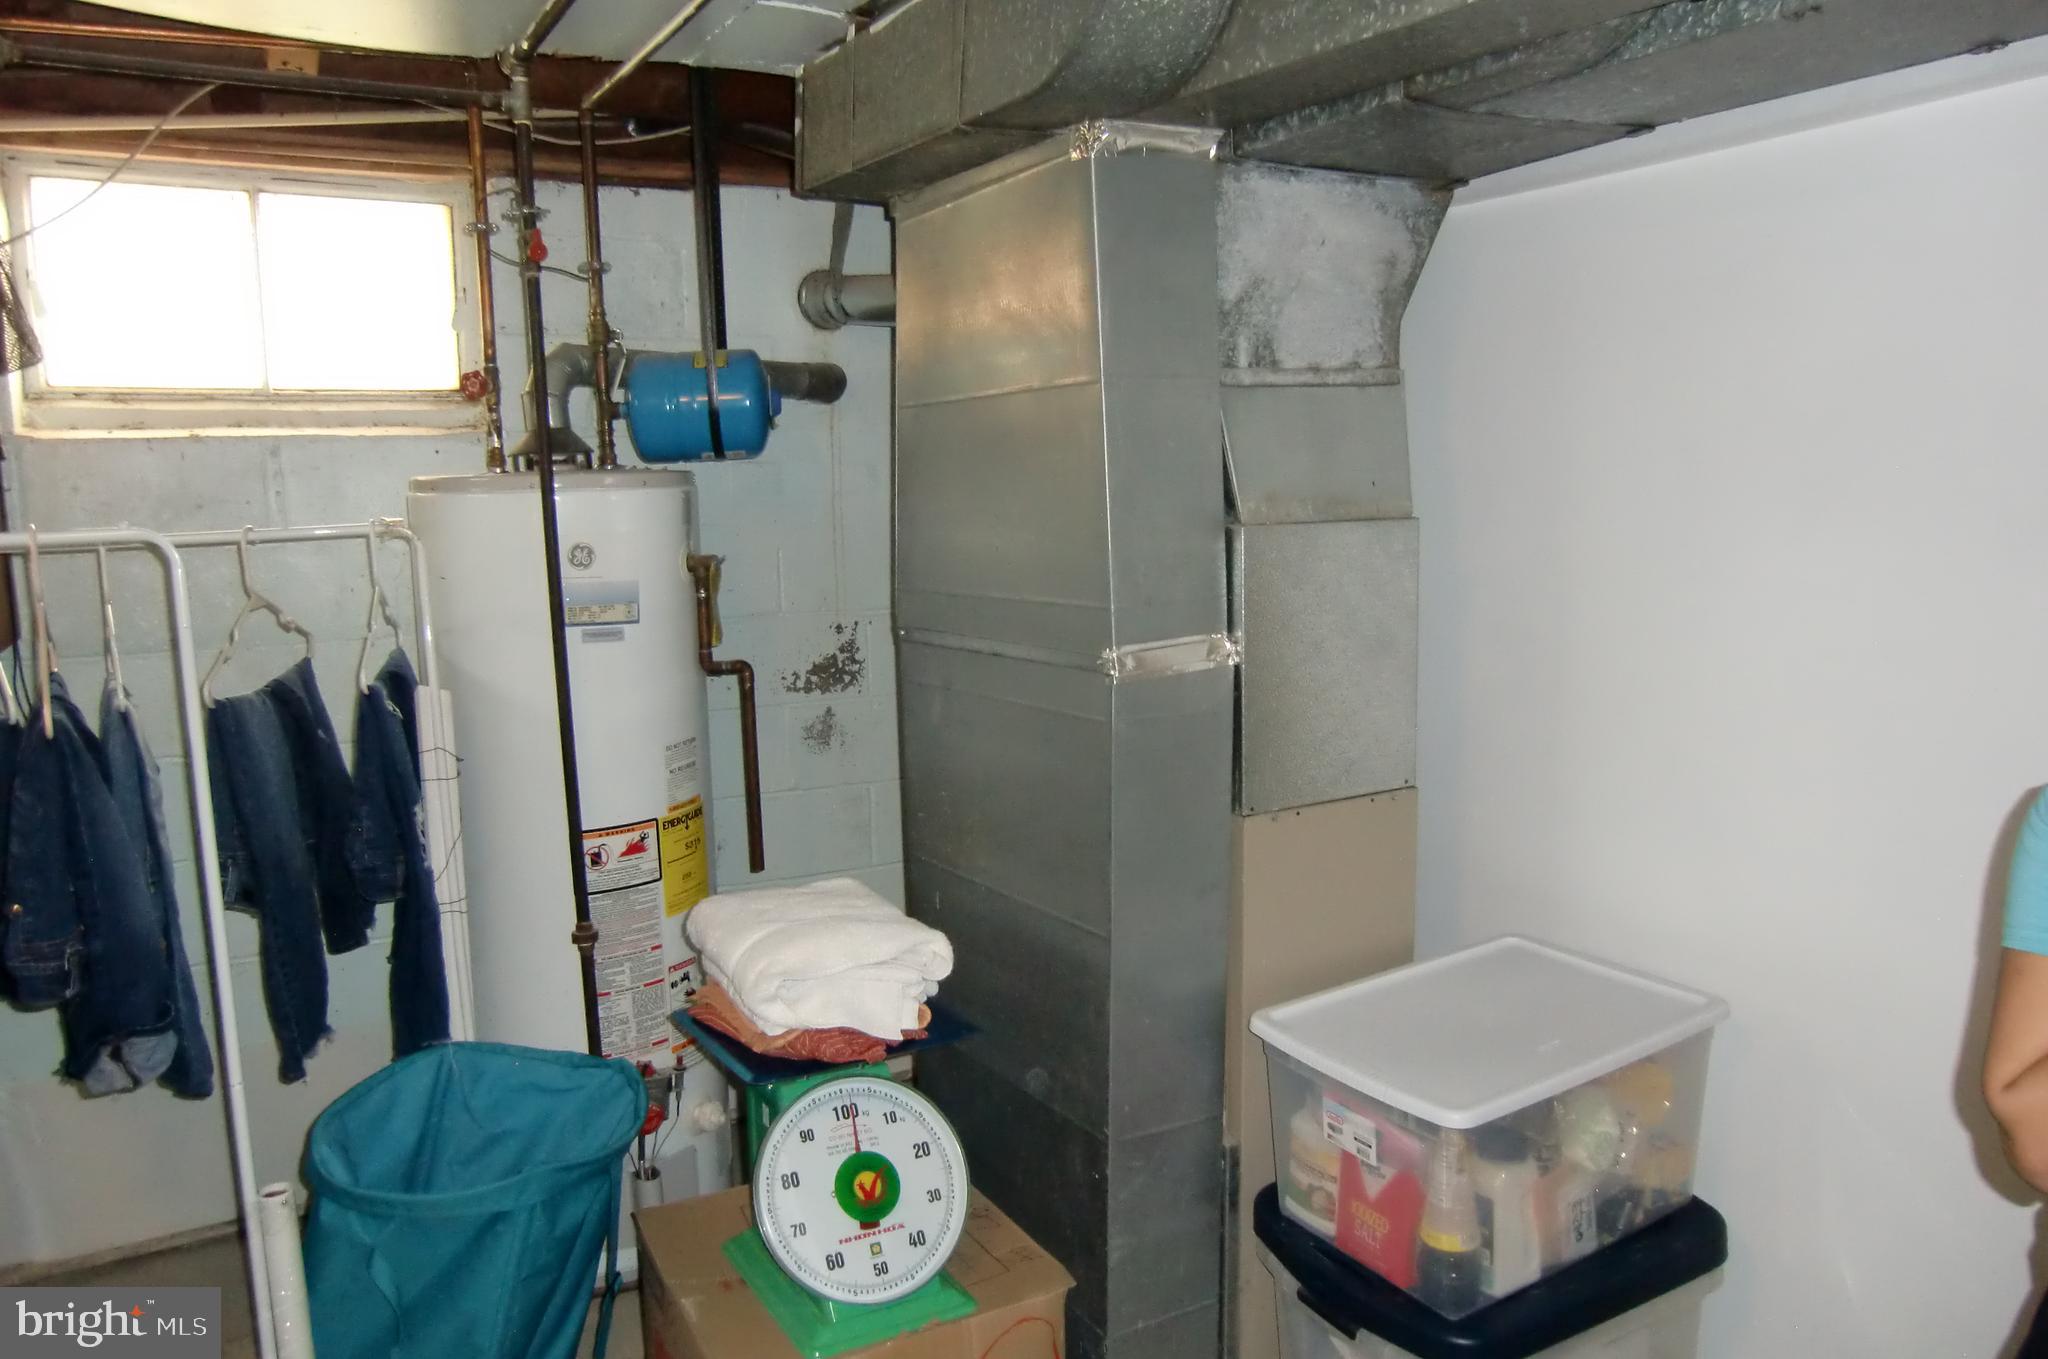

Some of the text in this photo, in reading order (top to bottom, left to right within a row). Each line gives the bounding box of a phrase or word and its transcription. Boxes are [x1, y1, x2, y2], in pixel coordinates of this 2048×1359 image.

[832, 1103, 859, 1122] 100
[882, 1110, 897, 1125] 10
[800, 1128, 815, 1143] 90
[913, 1141, 931, 1159] 20
[781, 1171, 800, 1190] 80
[927, 1188, 942, 1203] 30
[790, 1222, 807, 1238] 70
[908, 1230, 926, 1248] 40
[825, 1252, 845, 1271] 60
[873, 1261, 889, 1277] 50
